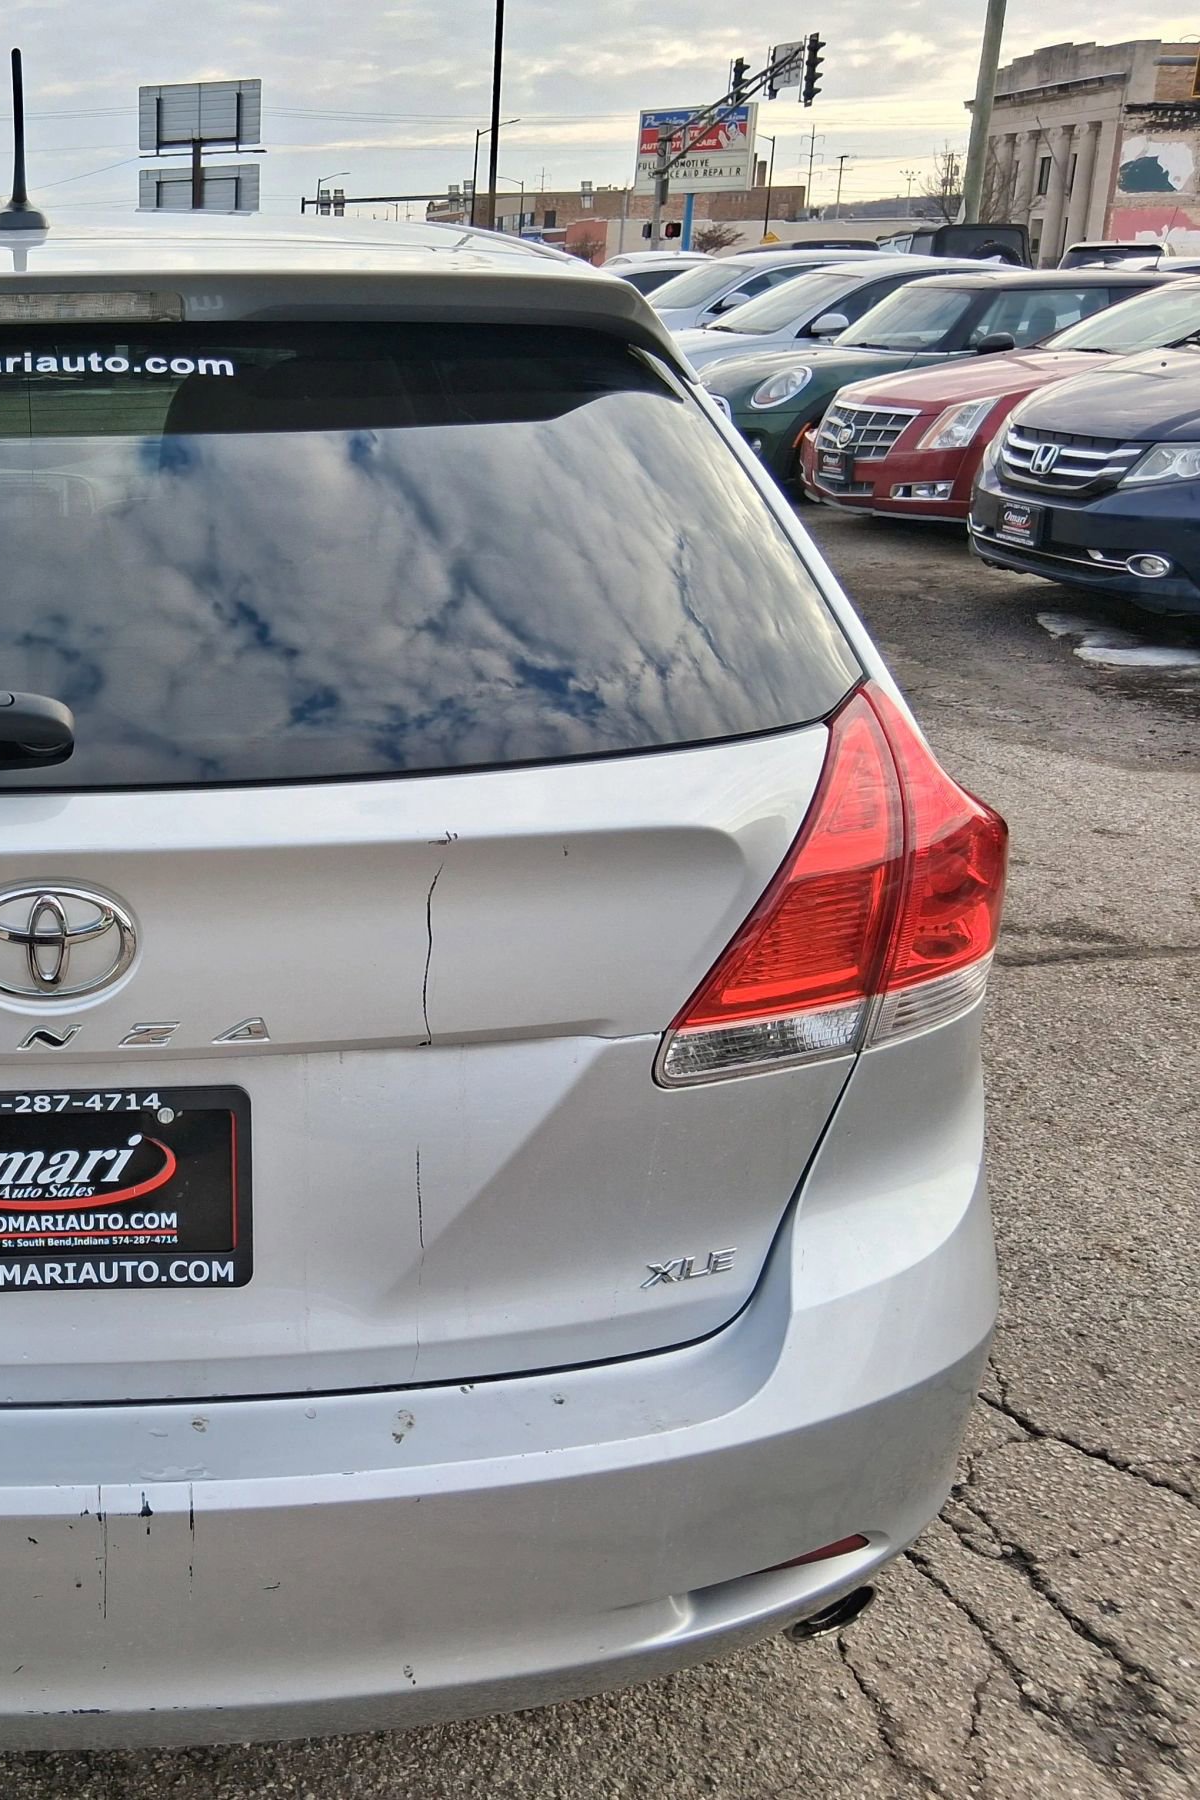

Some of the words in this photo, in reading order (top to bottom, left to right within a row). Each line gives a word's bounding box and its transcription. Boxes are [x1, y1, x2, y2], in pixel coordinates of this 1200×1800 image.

[638, 162, 657, 170] FULL
[45, 1183, 96, 1198] Sales
[1, 1239, 15, 1248] St.
[16, 1238, 46, 1248] South
[112, 1234, 179, 1245] 574-287-4714
[639, 1246, 738, 1289] XLE
